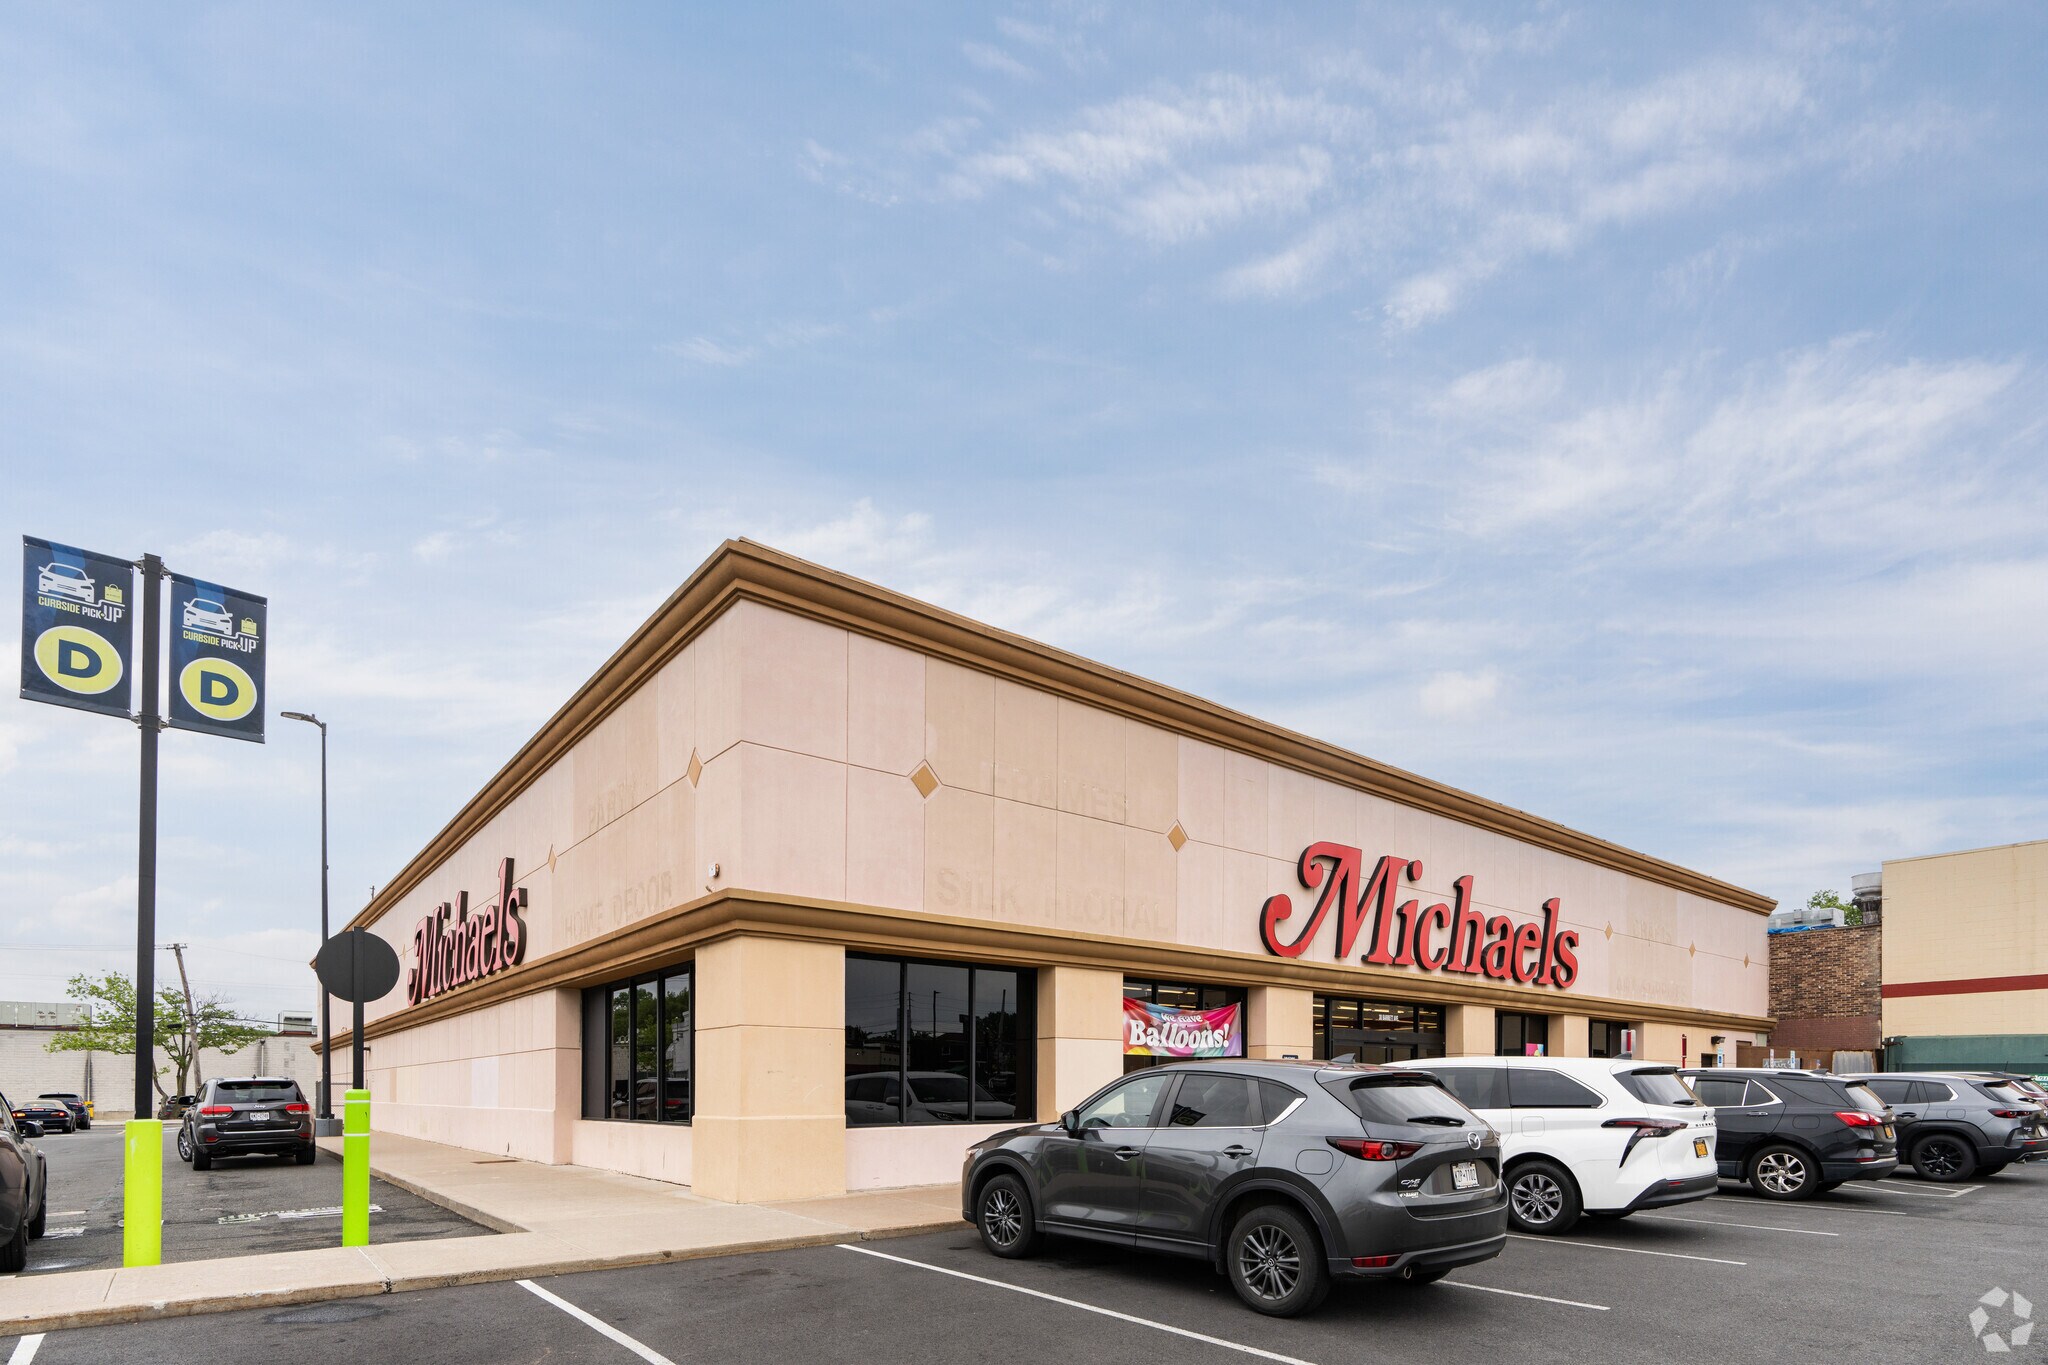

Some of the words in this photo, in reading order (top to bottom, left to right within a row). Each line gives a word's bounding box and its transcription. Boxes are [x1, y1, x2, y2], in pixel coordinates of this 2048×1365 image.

[38, 596, 80, 614] CURBSIDE
[183, 630, 220, 646] CURBSIDE
[58, 638, 102, 679] D
[201, 670, 239, 706] D
[1259, 841, 1579, 988] Michaels
[407, 857, 528, 1007] Michaels
[1129, 1019, 1230, 1049] Balloons!
[1161, 1013, 1176, 1022] We
